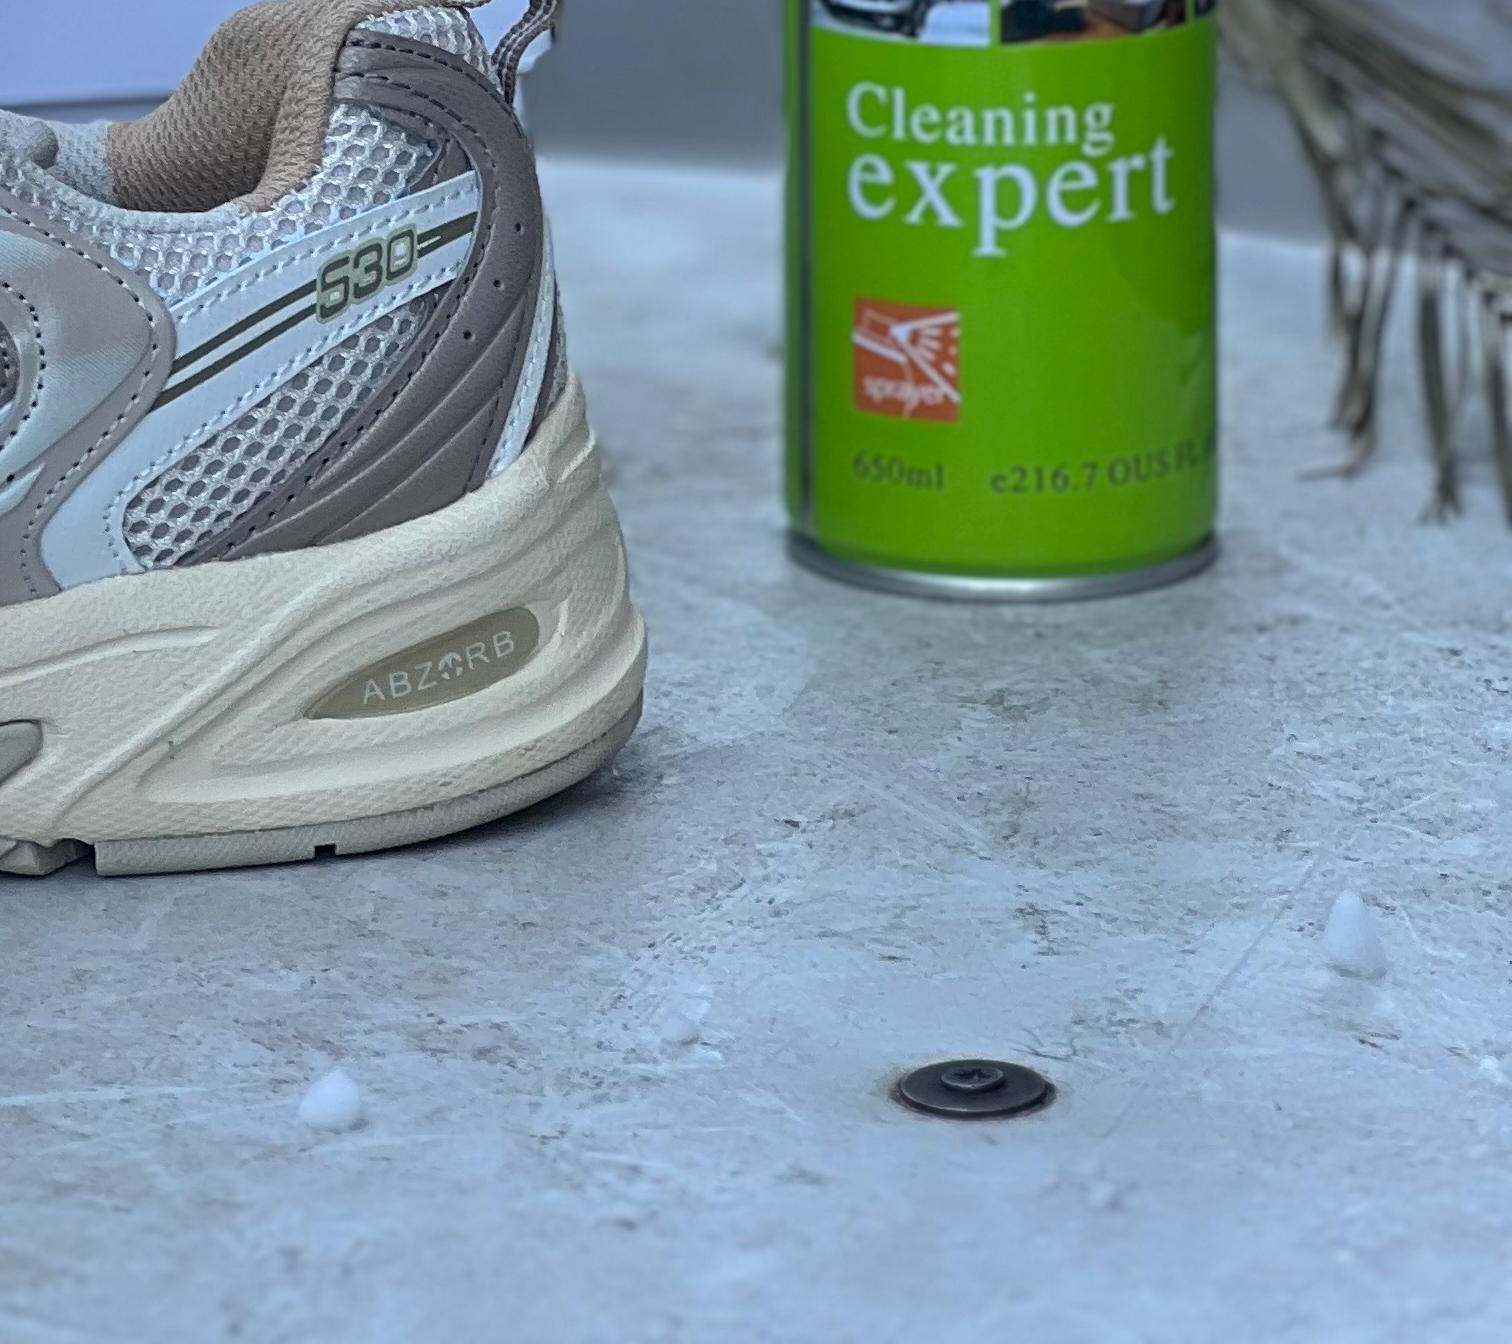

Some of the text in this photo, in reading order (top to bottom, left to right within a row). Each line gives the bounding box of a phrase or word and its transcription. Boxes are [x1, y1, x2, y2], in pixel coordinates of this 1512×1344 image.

[846, 81, 1115, 156] Cleaning
[846, 134, 1176, 257] expert
[318, 226, 416, 320] 530
[852, 450, 945, 491] 650ml
[363, 630, 516, 704] ABZORB
